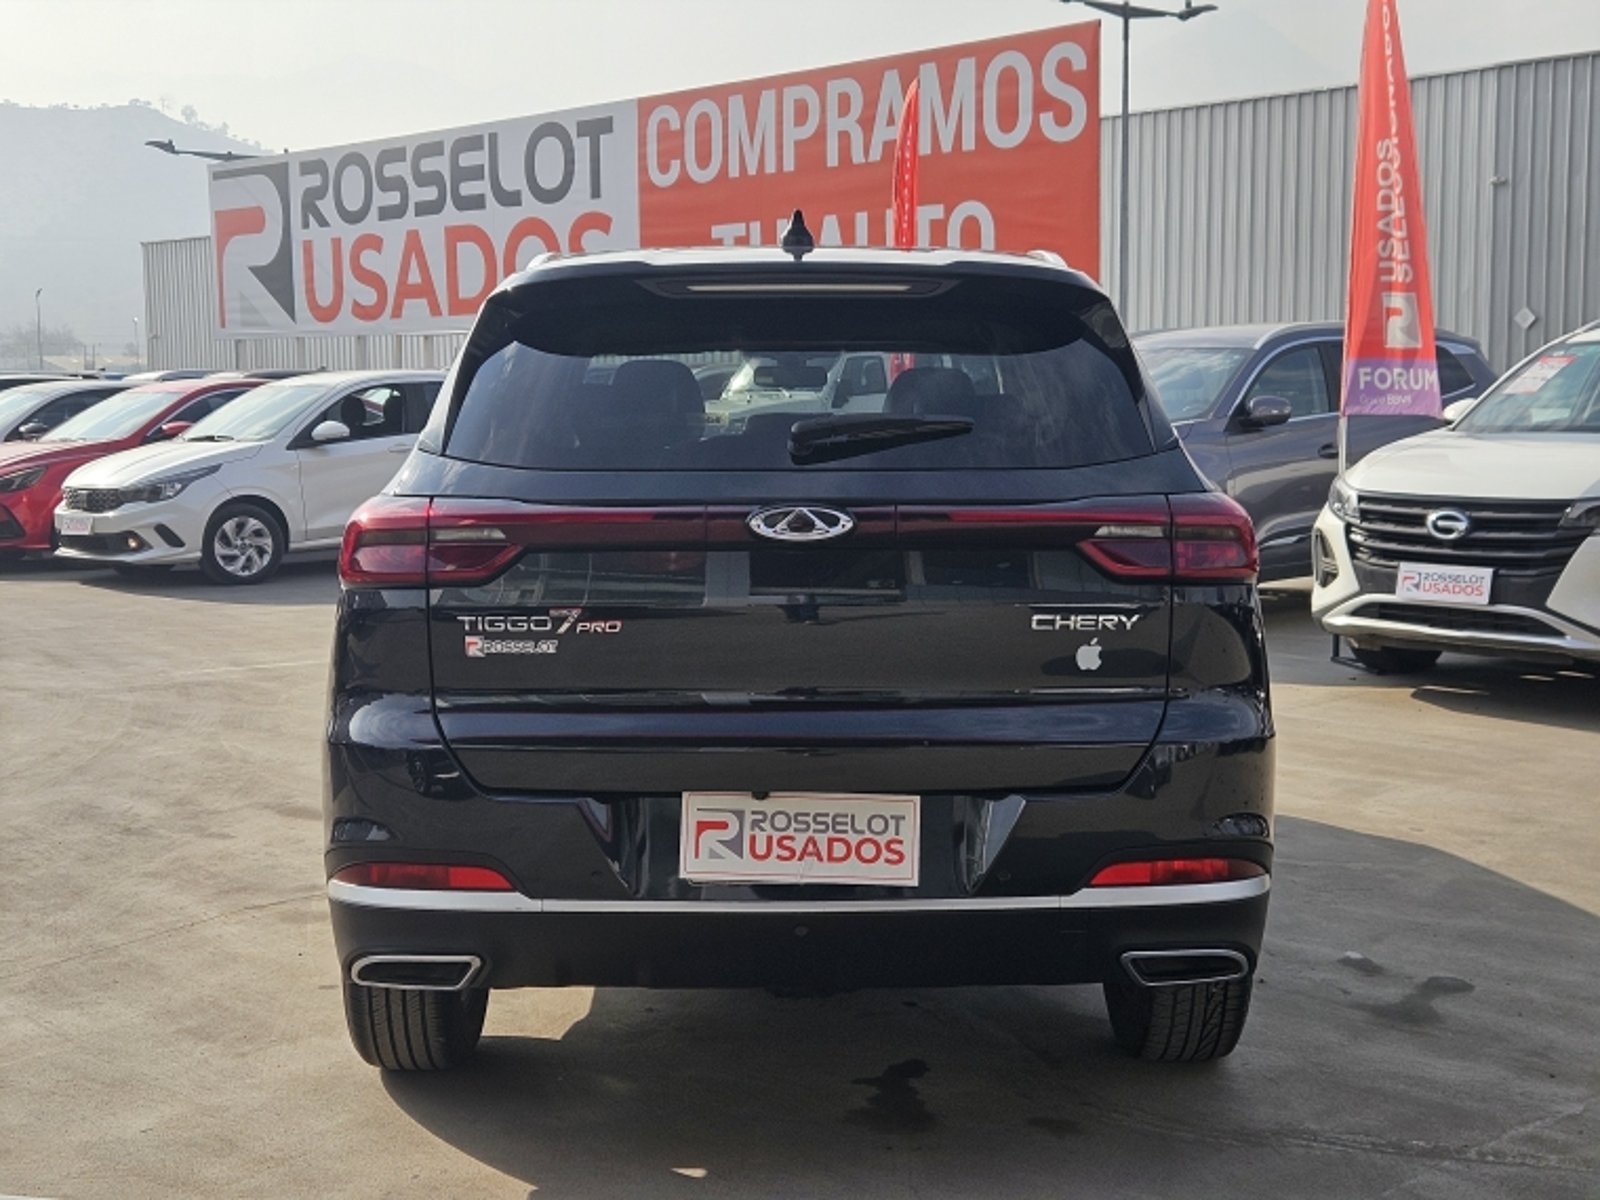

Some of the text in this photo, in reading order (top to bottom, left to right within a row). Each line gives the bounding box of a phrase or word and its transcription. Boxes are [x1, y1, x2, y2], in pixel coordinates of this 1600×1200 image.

[646, 41, 1088, 188] COMPRAMOS
[1382, 0, 1413, 283] SELECCIONADO
[300, 115, 614, 229] ROSSELOT
[1376, 138, 1397, 283] USADOS
[1358, 367, 1438, 392] FORUM
[1422, 582, 1484, 596] USADOS
[457, 616, 551, 631] TIGGO
[576, 621, 622, 633] PRO
[1031, 614, 1140, 630] CHERY
[750, 811, 906, 836] ROSSELOT
[749, 834, 905, 865] USADOS
